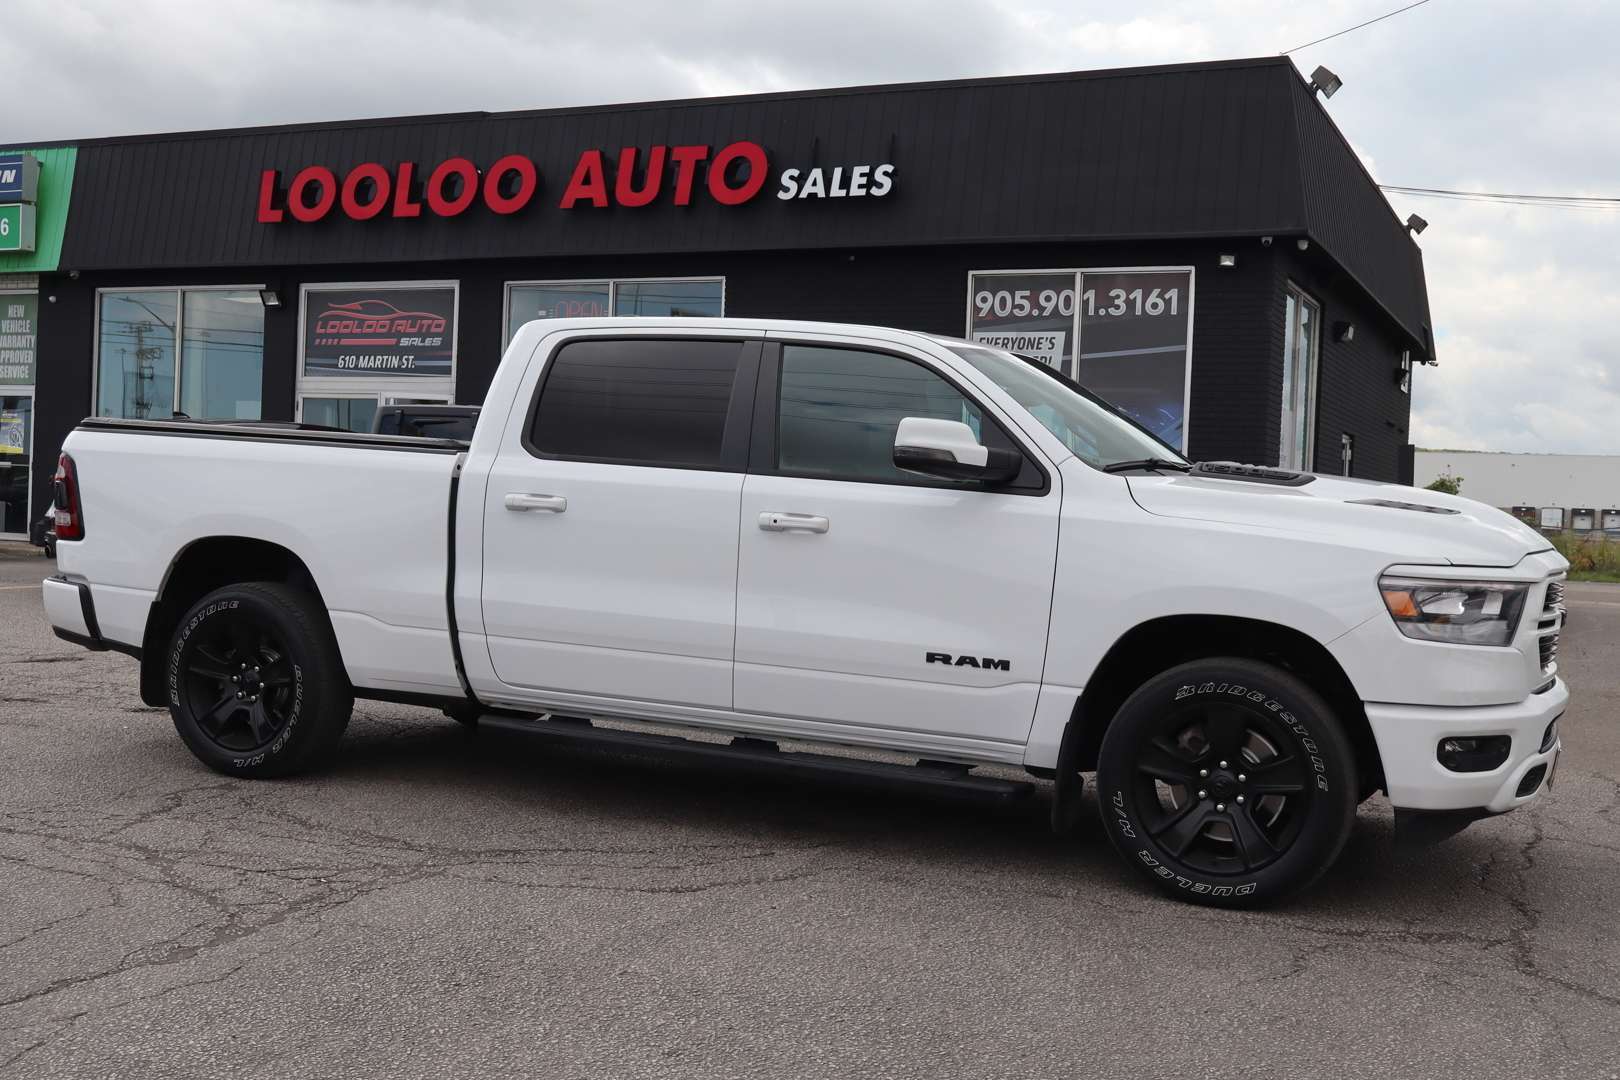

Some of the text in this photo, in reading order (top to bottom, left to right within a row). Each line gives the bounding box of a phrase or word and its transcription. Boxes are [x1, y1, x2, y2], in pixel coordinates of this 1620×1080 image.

[258, 141, 895, 223] LOOLOO AUTO SALES
[975, 288, 1179, 317] 905.901.3161
[8, 304, 25, 318] NEW
[1, 319, 32, 333] VEHICLE
[315, 319, 447, 334] LOOLOO AUTO
[399, 337, 443, 346] SALES
[0, 350, 34, 363] PPROVED
[337, 355, 415, 368] 610 MARTIN ST.
[925, 651, 1010, 671] RAM
[1175, 682, 1329, 792] BRIDGESTONE
[1138, 850, 1257, 897] DUELER
